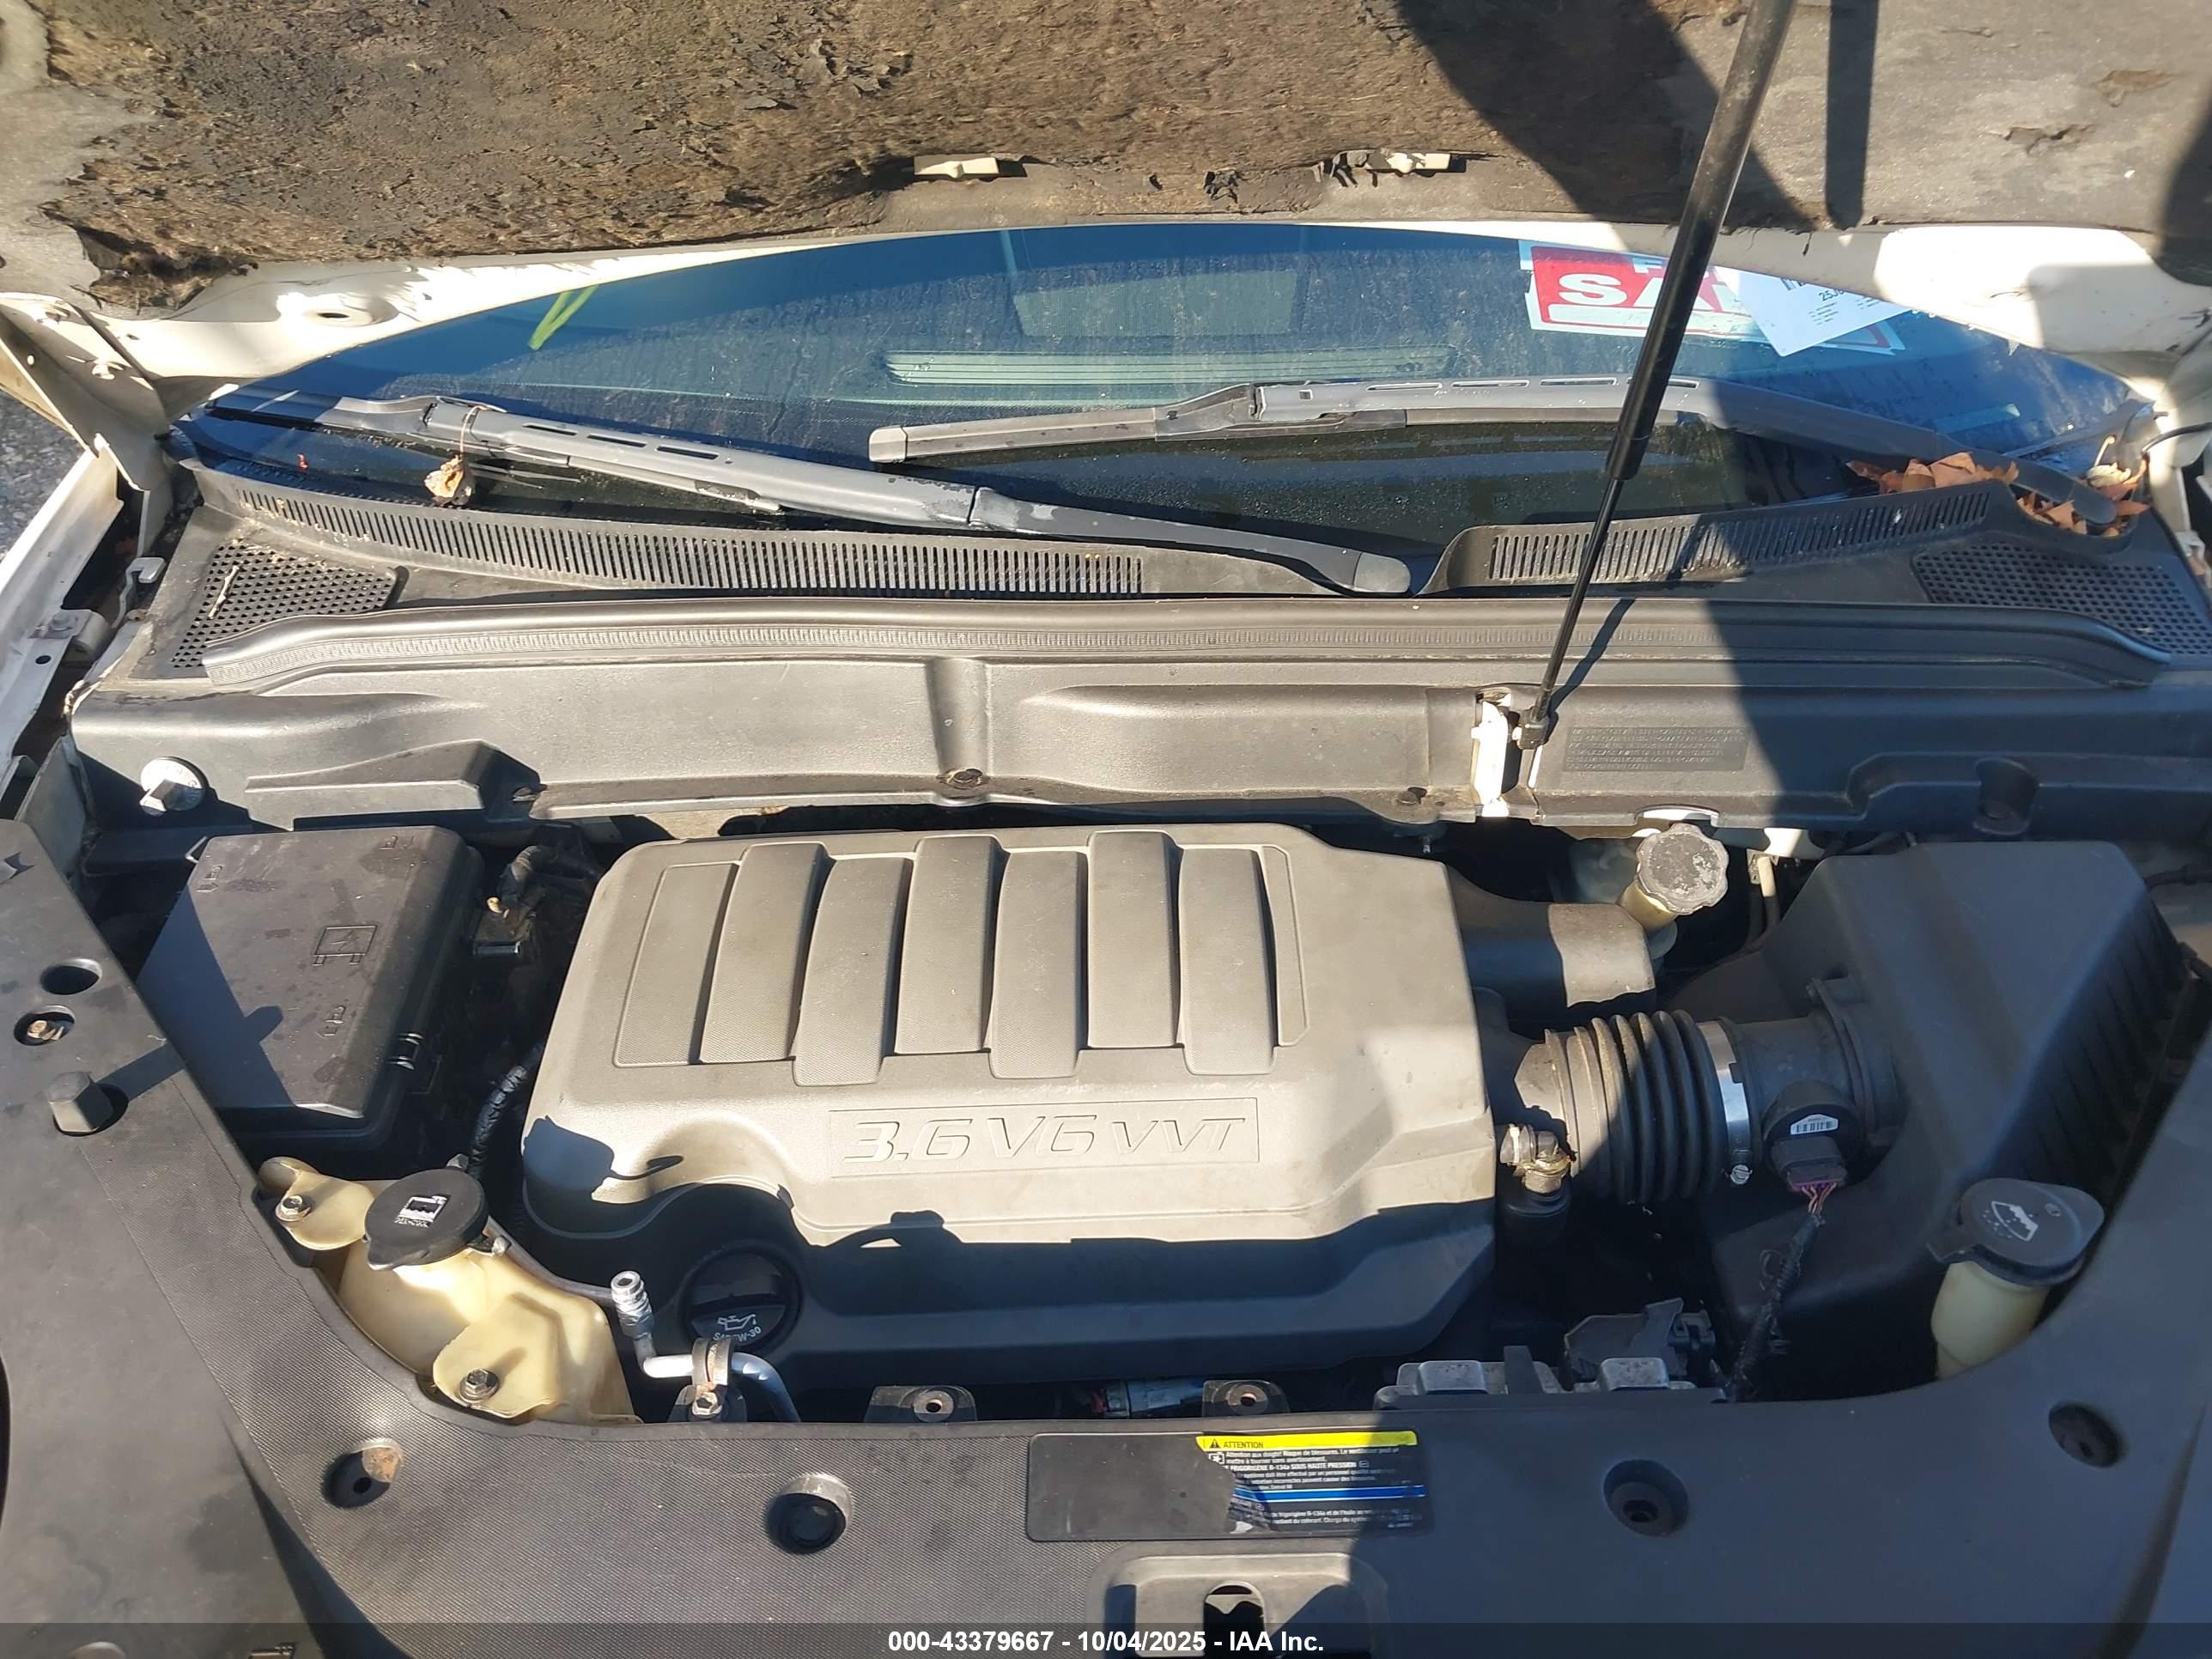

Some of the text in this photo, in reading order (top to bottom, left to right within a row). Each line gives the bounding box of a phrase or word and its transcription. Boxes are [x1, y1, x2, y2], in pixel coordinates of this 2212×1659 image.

[842, 1115, 1246, 1163] 3.6 V6 VVT
[1223, 1441, 1264, 1449] ATTENTION
